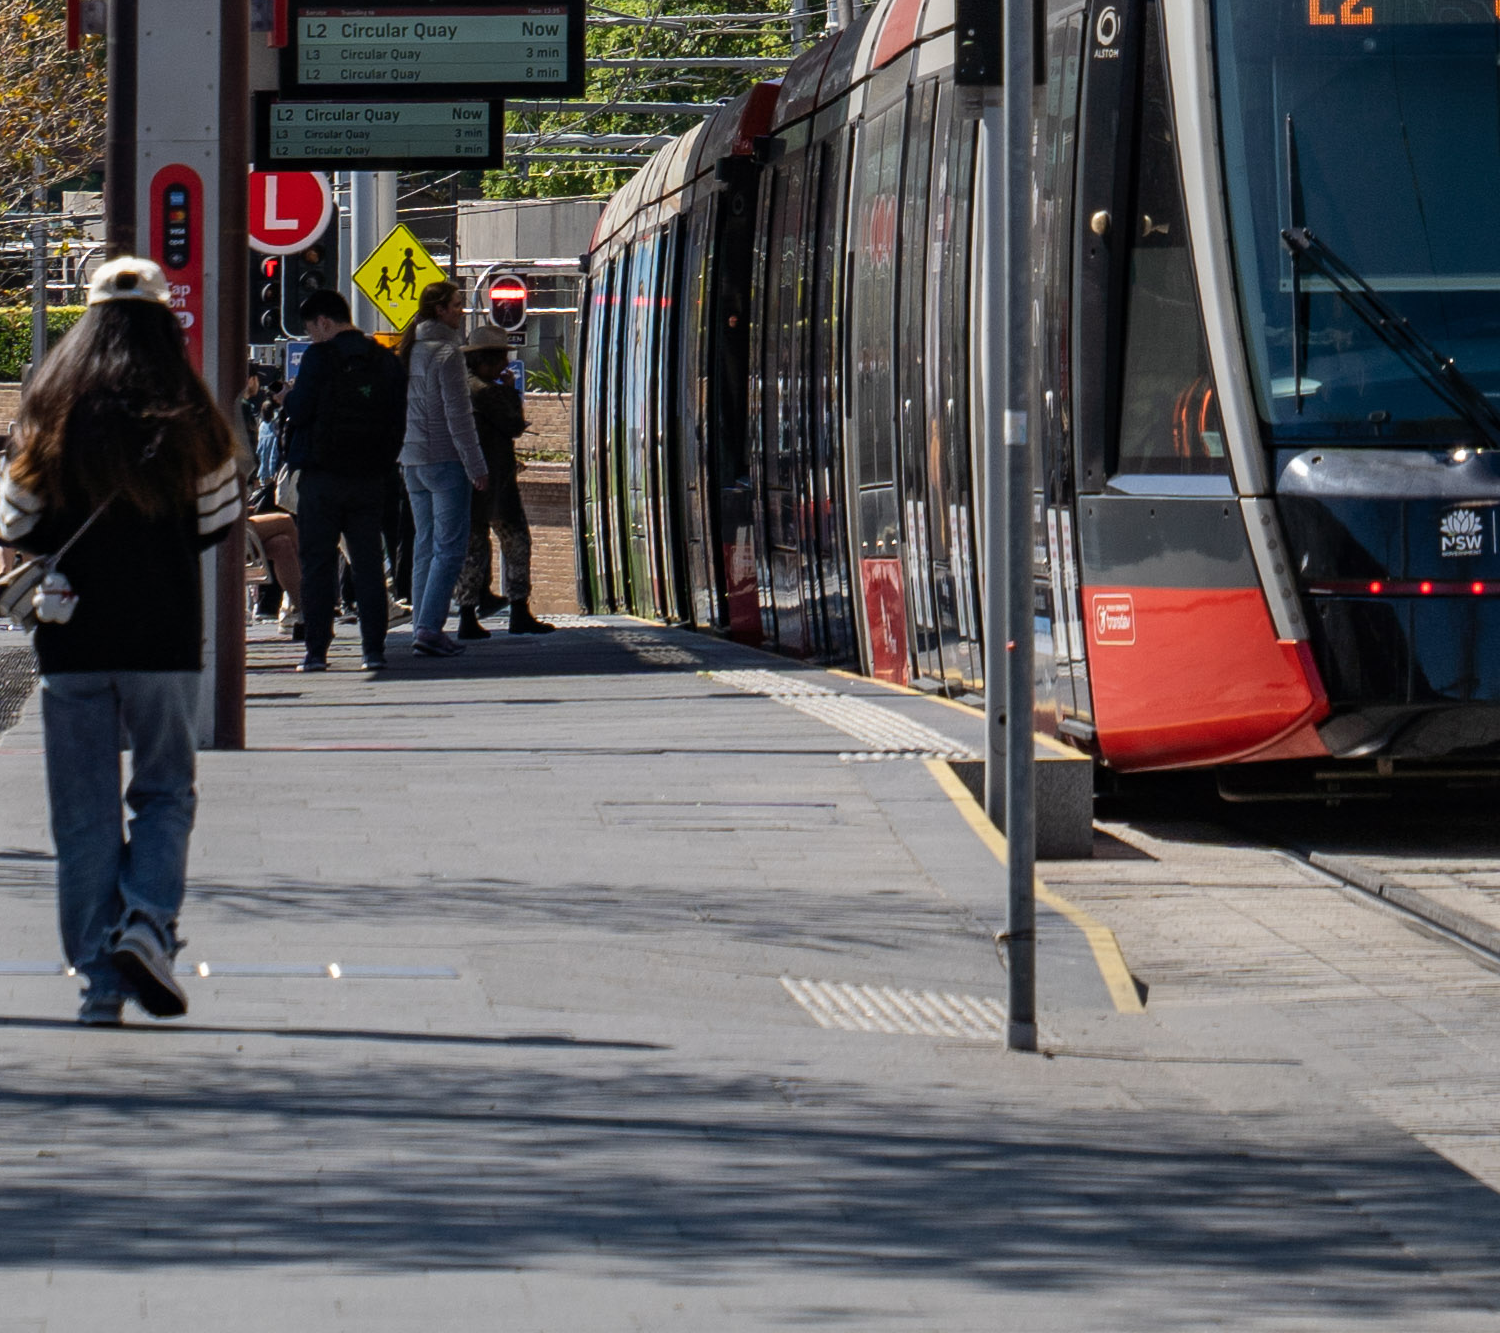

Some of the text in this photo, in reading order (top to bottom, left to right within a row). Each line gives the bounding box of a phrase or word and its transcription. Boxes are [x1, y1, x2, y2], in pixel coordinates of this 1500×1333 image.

[306, 21, 559, 40] L2 Circular Quay Now
[306, 47, 559, 62] L3 Circular Quay 3 min
[1094, 49, 1119, 58] ALSTOM
[306, 67, 559, 81] L2 Circular Quay 8 min
[277, 108, 482, 123] L2 Circular Quay Now
[276, 128, 482, 140] L3 Circular Quay 3 min
[276, 145, 482, 156] L2 Circular Quay 8 min
[264, 175, 299, 230] L
[1441, 535, 1482, 551] NSW
